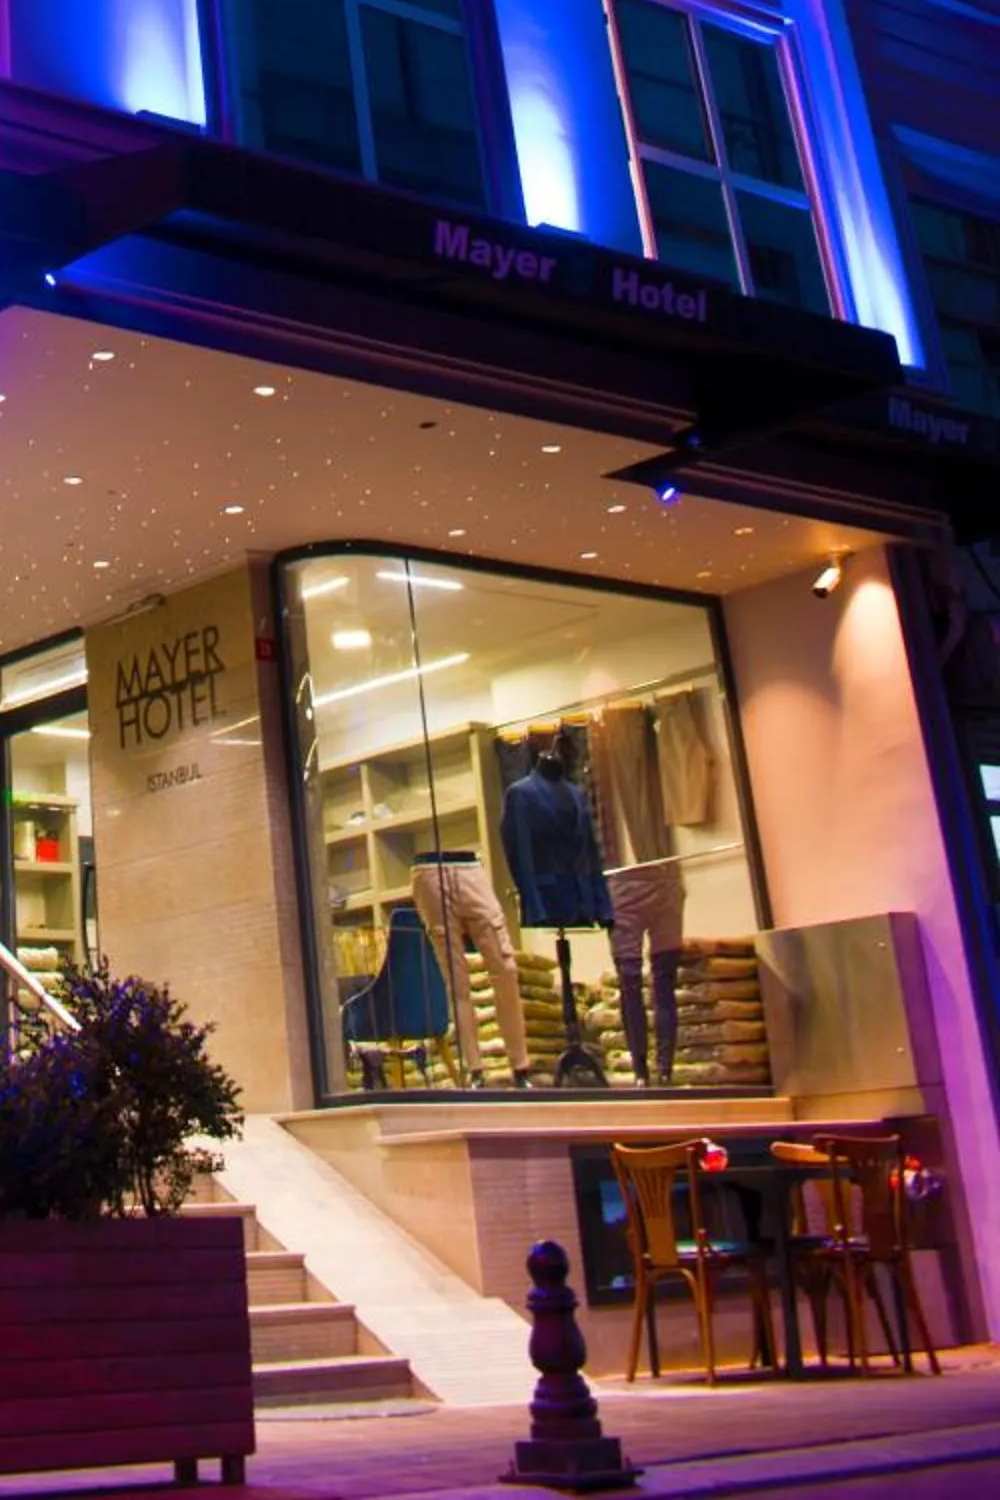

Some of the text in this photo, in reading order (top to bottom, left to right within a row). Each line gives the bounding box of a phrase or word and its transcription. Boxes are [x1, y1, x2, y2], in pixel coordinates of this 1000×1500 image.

[432, 219, 709, 324] Mayer Hotel
[887, 395, 968, 445] Mayer
[116, 626, 225, 709] MAYER
[118, 671, 226, 749] HOTEL
